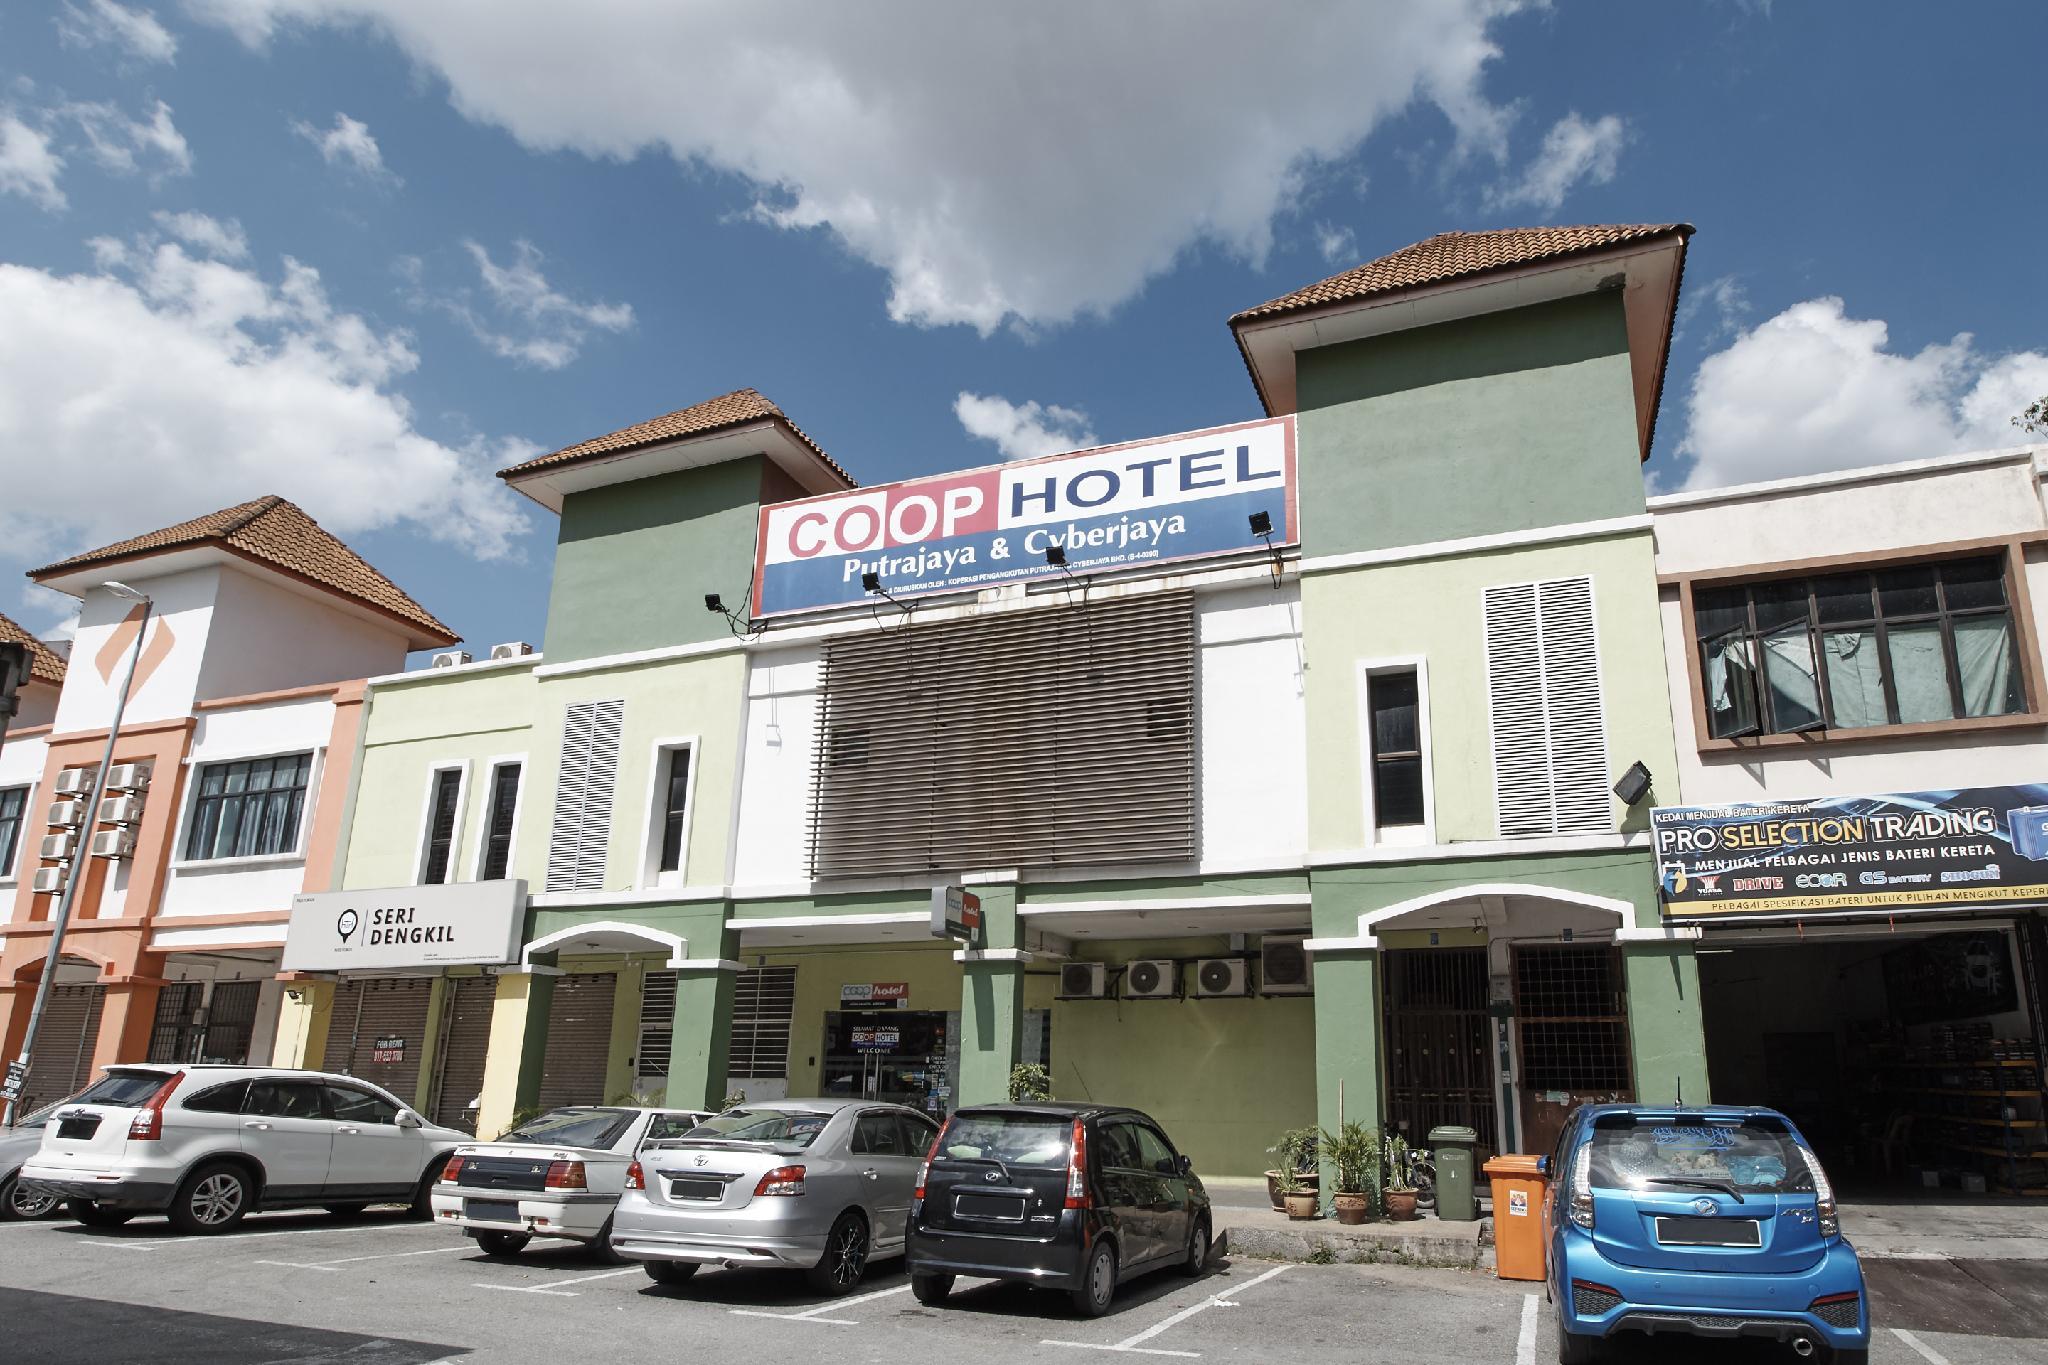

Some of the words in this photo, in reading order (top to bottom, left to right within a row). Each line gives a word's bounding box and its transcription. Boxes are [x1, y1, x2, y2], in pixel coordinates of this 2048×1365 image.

[788, 486, 984, 558] COOP
[1011, 445, 1281, 518] HOTEL
[843, 546, 977, 583] Putrajaya
[989, 537, 1010, 560] &
[1024, 514, 1186, 554] Cyberjaya
[948, 574, 978, 586] KOPERASI
[979, 565, 1028, 582] PENGANGKUTAN
[1029, 562, 1066, 576] PUTRAJ
[1072, 556, 1110, 569] CYBERJAYA
[1655, 813, 1684, 823] KEDAI
[1686, 810, 1731, 821] MENJUAL
[1733, 807, 1768, 817] BATERI
[1770, 804, 1810, 814] KERETA
[1660, 828, 1716, 852] PRO
[1722, 819, 1865, 848] SELECTION
[1870, 810, 1994, 839] TRADING
[1695, 858, 1760, 871] MENJUAL
[1766, 853, 1835, 867] PELBAGAI
[1841, 850, 1880, 863] JENIS
[1886, 847, 1934, 861] BATERI
[1940, 844, 1995, 858] KERETA
[1733, 876, 1784, 892] DRIVE
[1859, 870, 1887, 885] GS
[1888, 873, 1932, 884] BATTERY
[1941, 869, 2001, 883] SHOGUN
[1712, 901, 1760, 911] PELBAGAI
[1763, 898, 1824, 909] SPESIFIKASI
[1828, 895, 1863, 906] BATERI
[1867, 894, 1902, 904] UNTUK
[1906, 891, 1949, 902] PILIHAN
[1953, 889, 2007, 900] MENGIKUT
[373, 907, 415, 925] SERI
[370, 925, 455, 945] DENGKIL
[873, 984, 904, 995] hotel
[853, 1033, 875, 1041] COOP
[876, 1033, 898, 1041] HOTEL
